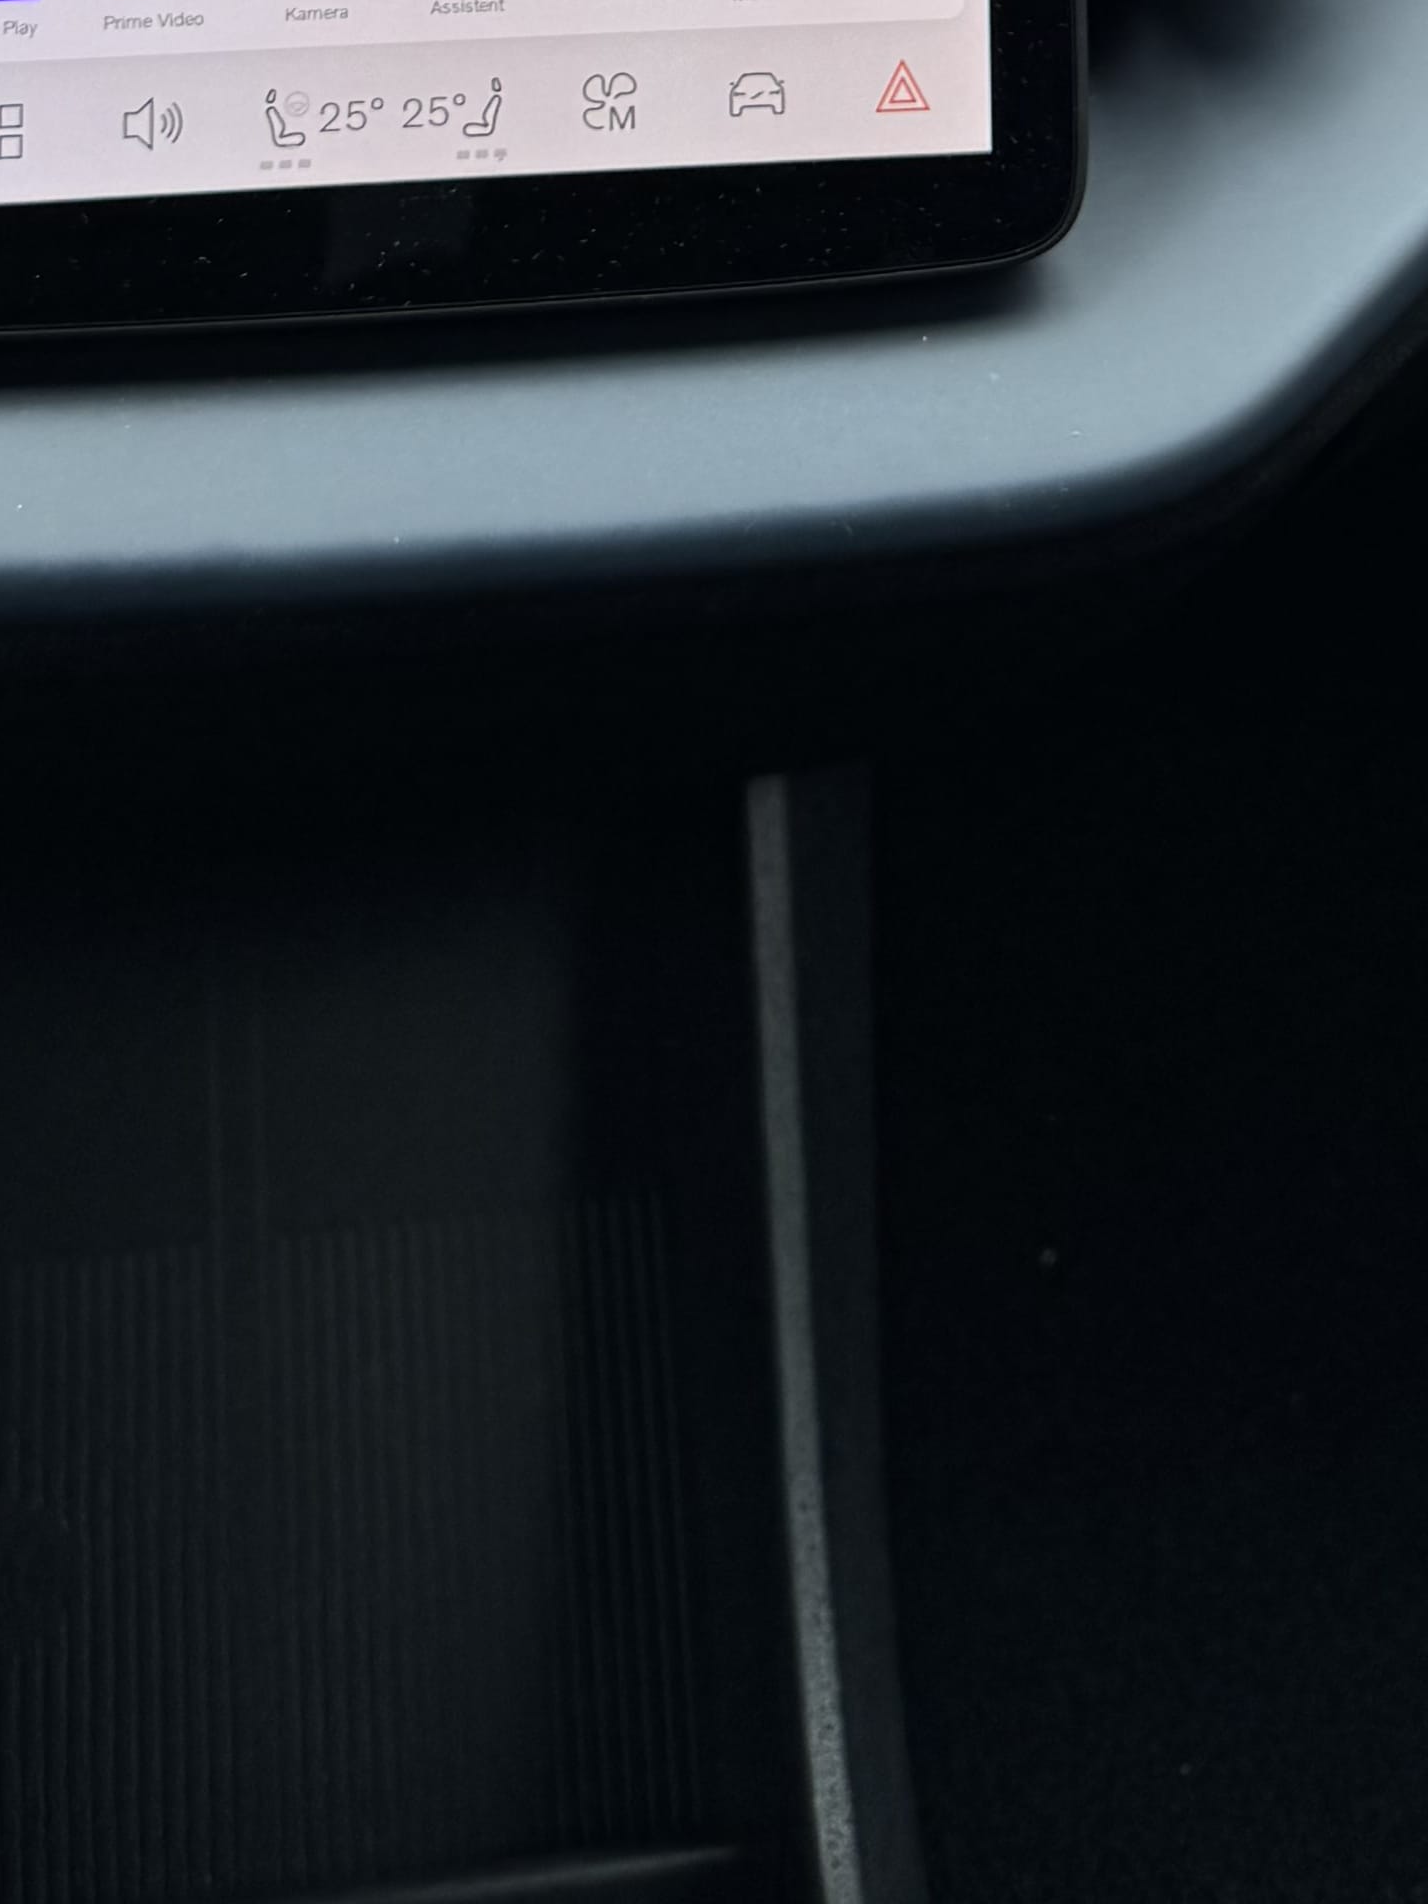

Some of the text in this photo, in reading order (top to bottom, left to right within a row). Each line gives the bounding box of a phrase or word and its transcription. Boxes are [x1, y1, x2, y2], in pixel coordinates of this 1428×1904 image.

[103, 11, 205, 31] Prime Video
[284, 5, 350, 22] Kamera
[2, 19, 39, 39] Play
[318, 96, 385, 133] 25°
[401, 92, 467, 129] 25°
